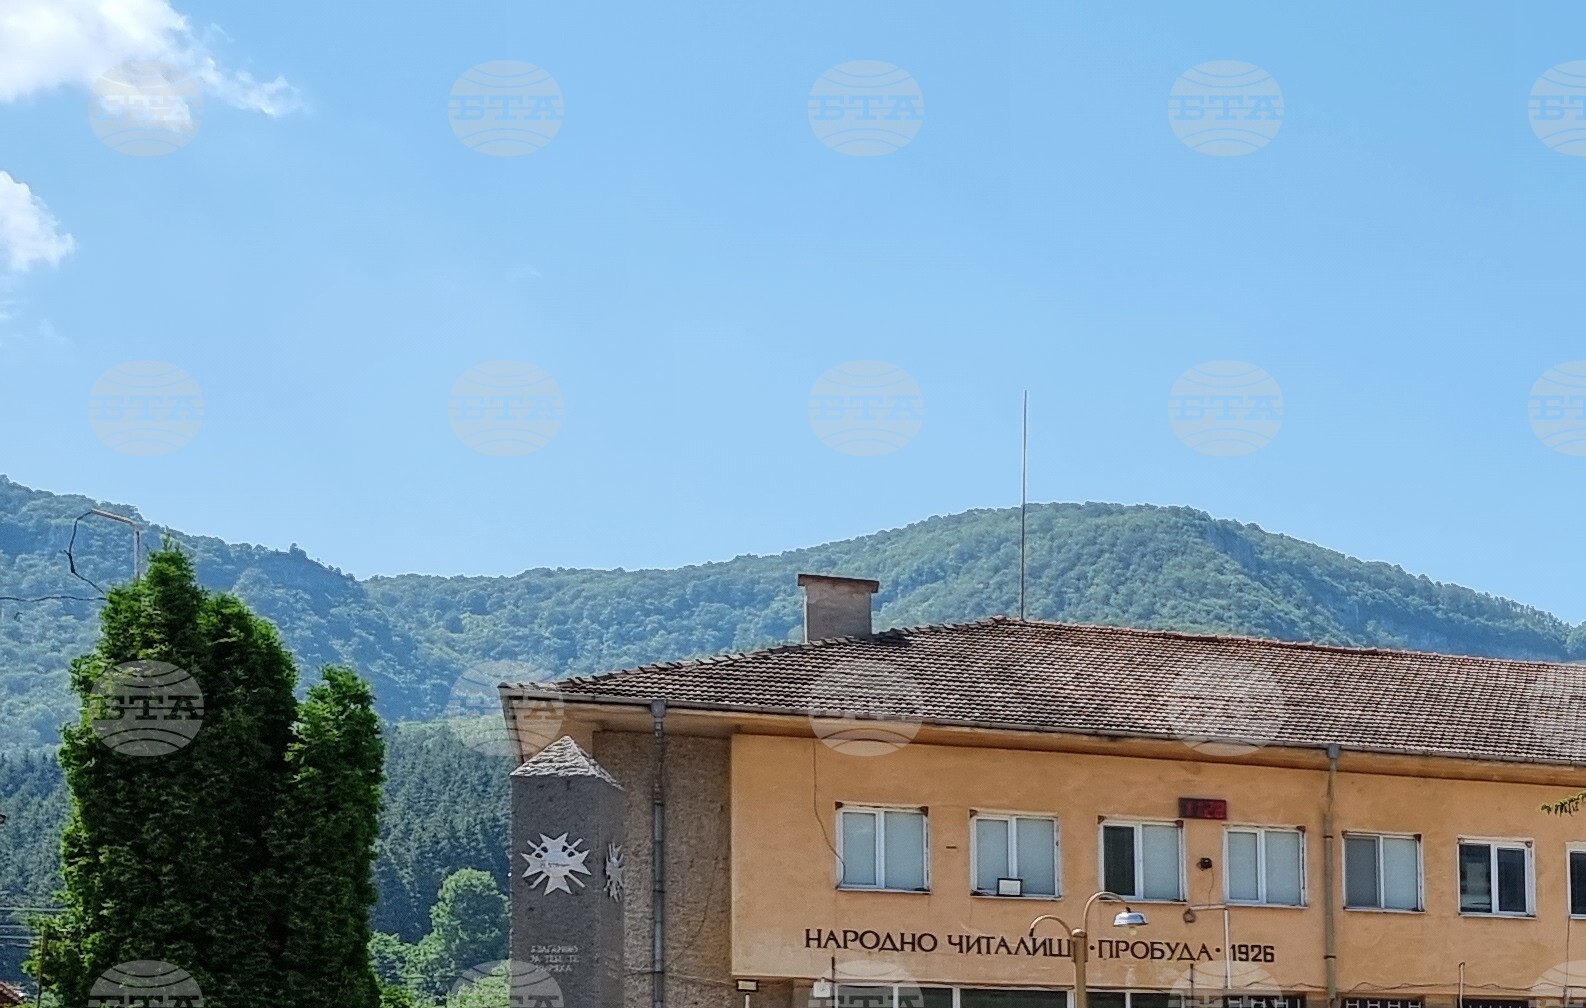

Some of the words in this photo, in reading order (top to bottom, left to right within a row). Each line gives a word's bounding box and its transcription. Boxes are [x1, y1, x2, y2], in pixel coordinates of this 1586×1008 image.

[804, 928, 938, 952] НАРОДНО
[946, 934, 1074, 958] ЧИТАЛИЩ
[1229, 944, 1275, 962] 1926
